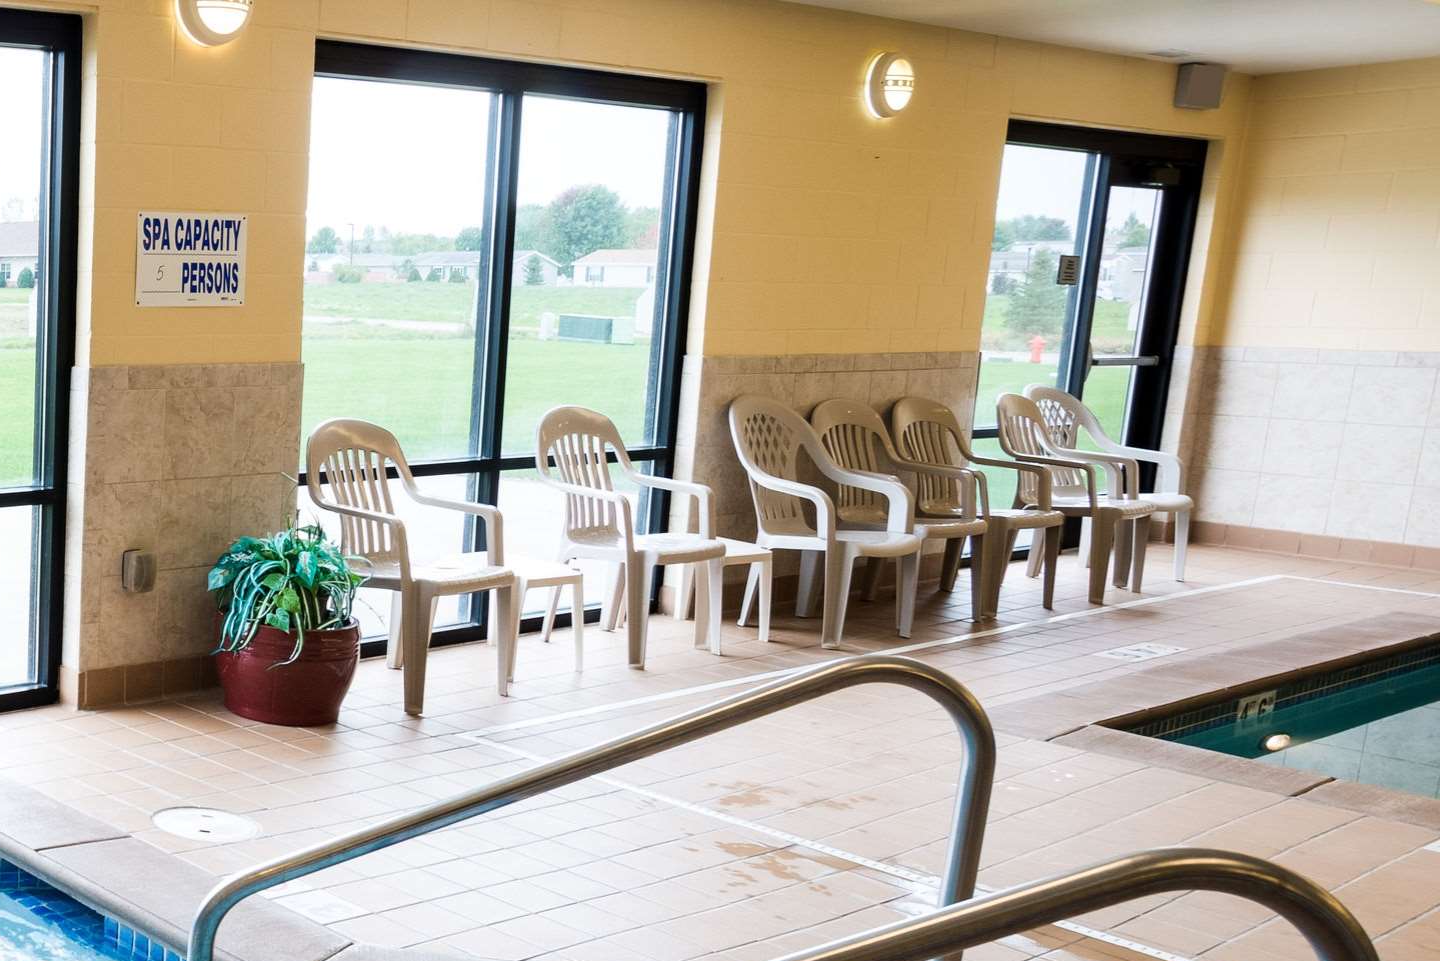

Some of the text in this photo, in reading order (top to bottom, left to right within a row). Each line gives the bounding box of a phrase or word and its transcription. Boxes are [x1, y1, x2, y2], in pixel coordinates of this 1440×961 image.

[143, 217, 241, 251] SPA CAPACITY
[181, 262, 239, 294] PERSONS
